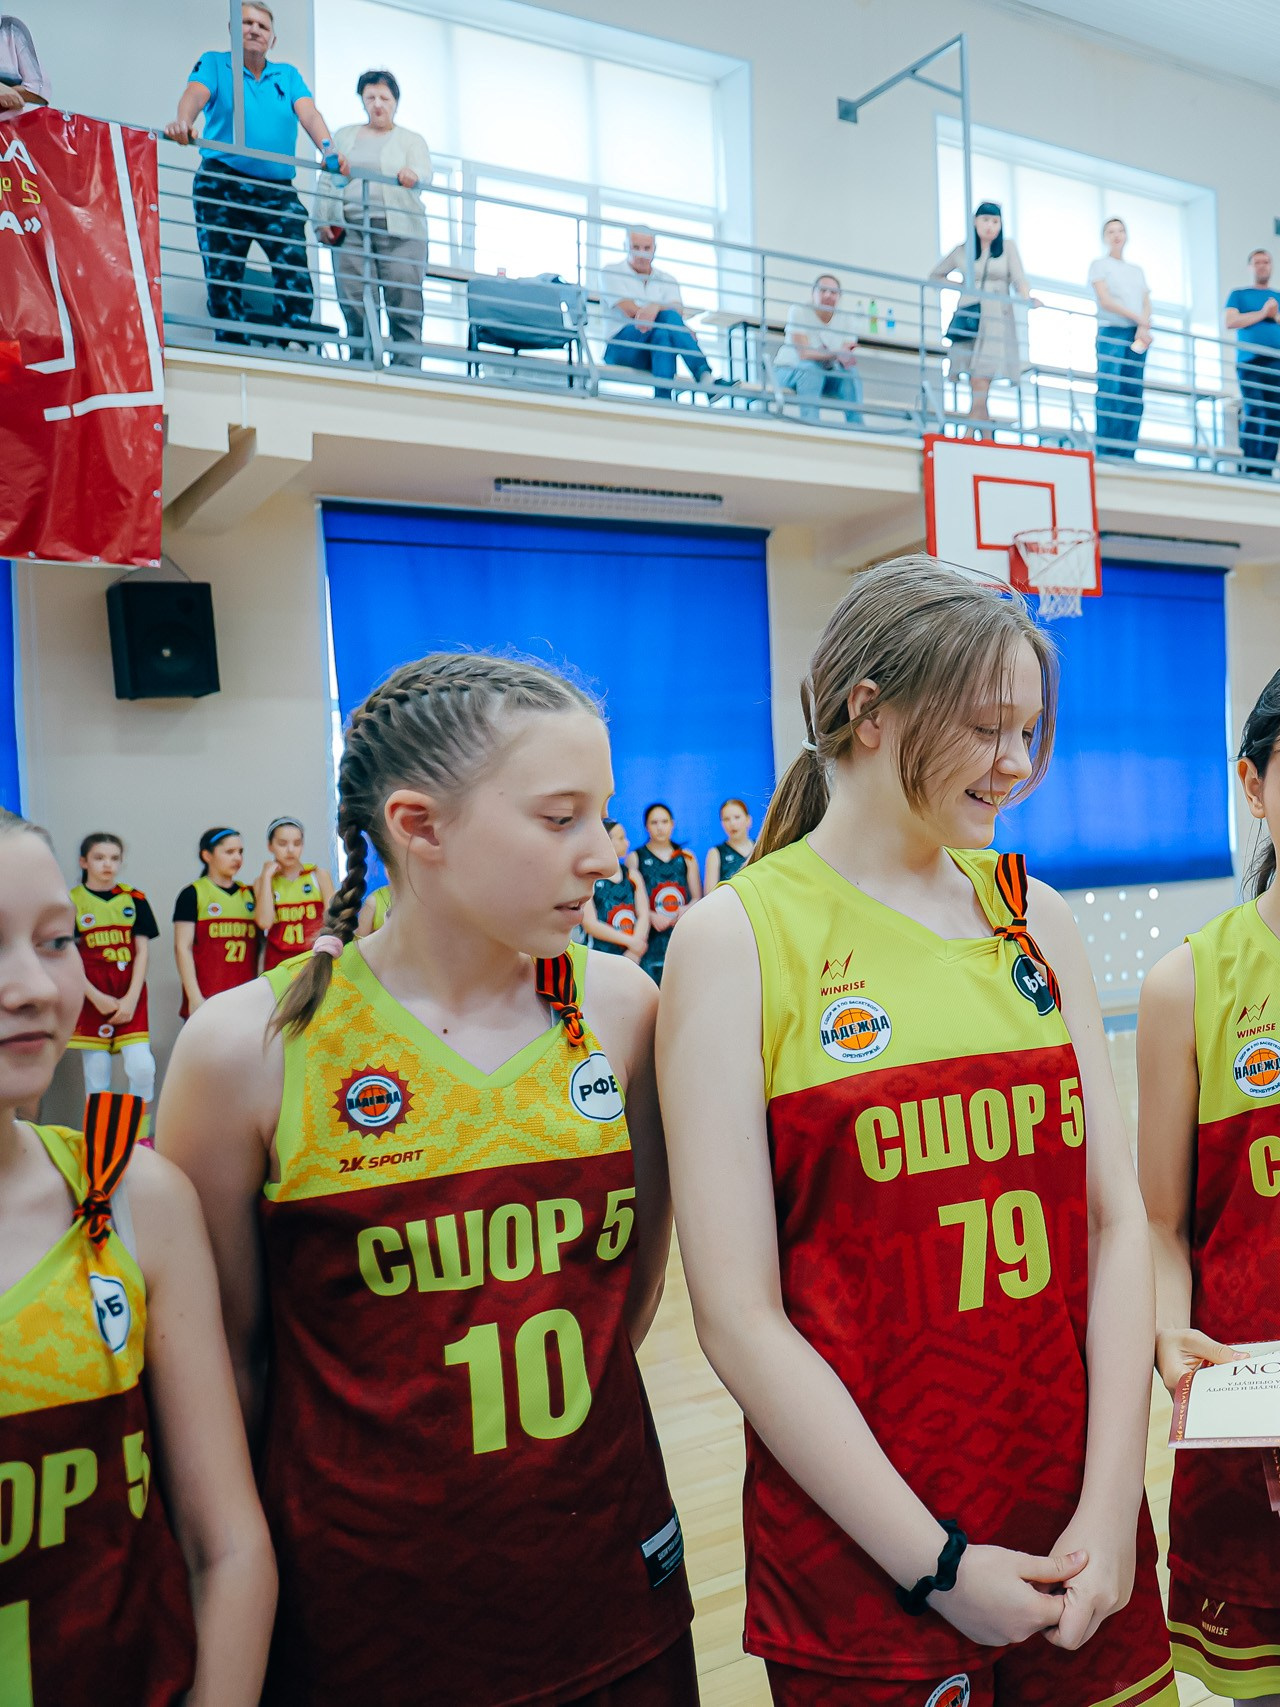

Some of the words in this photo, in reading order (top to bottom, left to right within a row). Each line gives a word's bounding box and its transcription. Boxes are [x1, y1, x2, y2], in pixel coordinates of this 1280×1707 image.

[282, 923, 305, 945] 41
[224, 940, 247, 963] 27
[820, 980, 866, 997] WINRISE
[820, 1015, 890, 1046] НАДЕЖДА
[1236, 1022, 1277, 1039] WINRISE
[854, 1082, 1047, 1183] СШОР
[1060, 1077, 1086, 1148] 5
[368, 1149, 424, 1169] SPORT
[357, 1197, 584, 1297] СШОР
[596, 1187, 636, 1261] 5
[938, 1189, 1053, 1313] 79
[444, 1308, 593, 1455] 10
